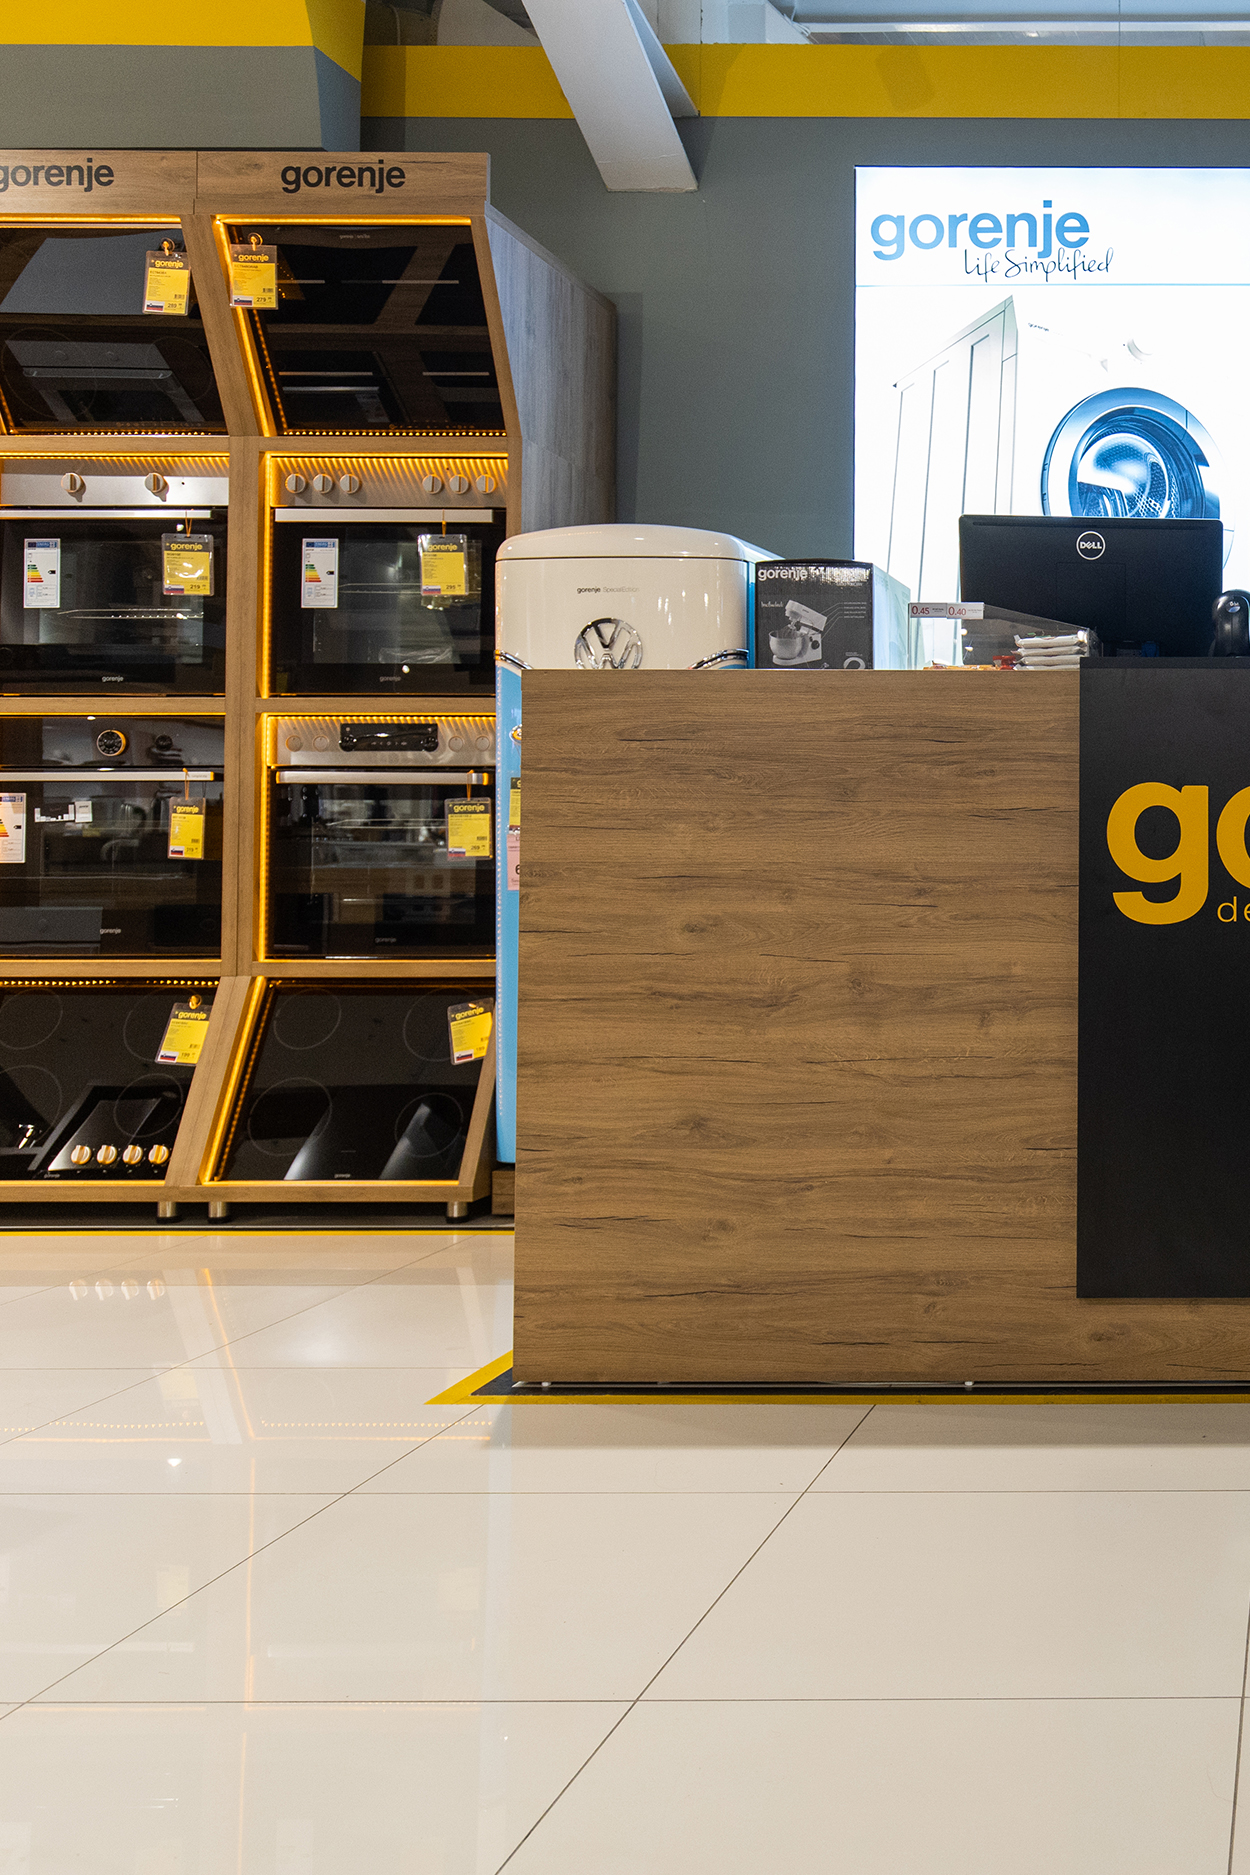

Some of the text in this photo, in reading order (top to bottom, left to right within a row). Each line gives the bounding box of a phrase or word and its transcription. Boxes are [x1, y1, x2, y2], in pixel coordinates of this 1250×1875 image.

[281, 159, 406, 194] gorenje
[871, 200, 1090, 260] gorenje
[238, 253, 269, 262] gorenje
[155, 259, 184, 269] gorenje
[1005, 247, 1114, 282] Simplified
[170, 542, 203, 551] gorenje
[428, 543, 458, 551] gorenje
[1080, 541, 1102, 550] DELL
[757, 566, 808, 581] gorenje
[576, 585, 601, 594] gorenje
[911, 605, 930, 615] 0.45
[948, 606, 967, 616] 0.40
[176, 805, 199, 814] gorenje
[453, 804, 485, 813] gorenje
[177, 1011, 207, 1021] gorenje
[455, 1006, 485, 1020] gorenje
